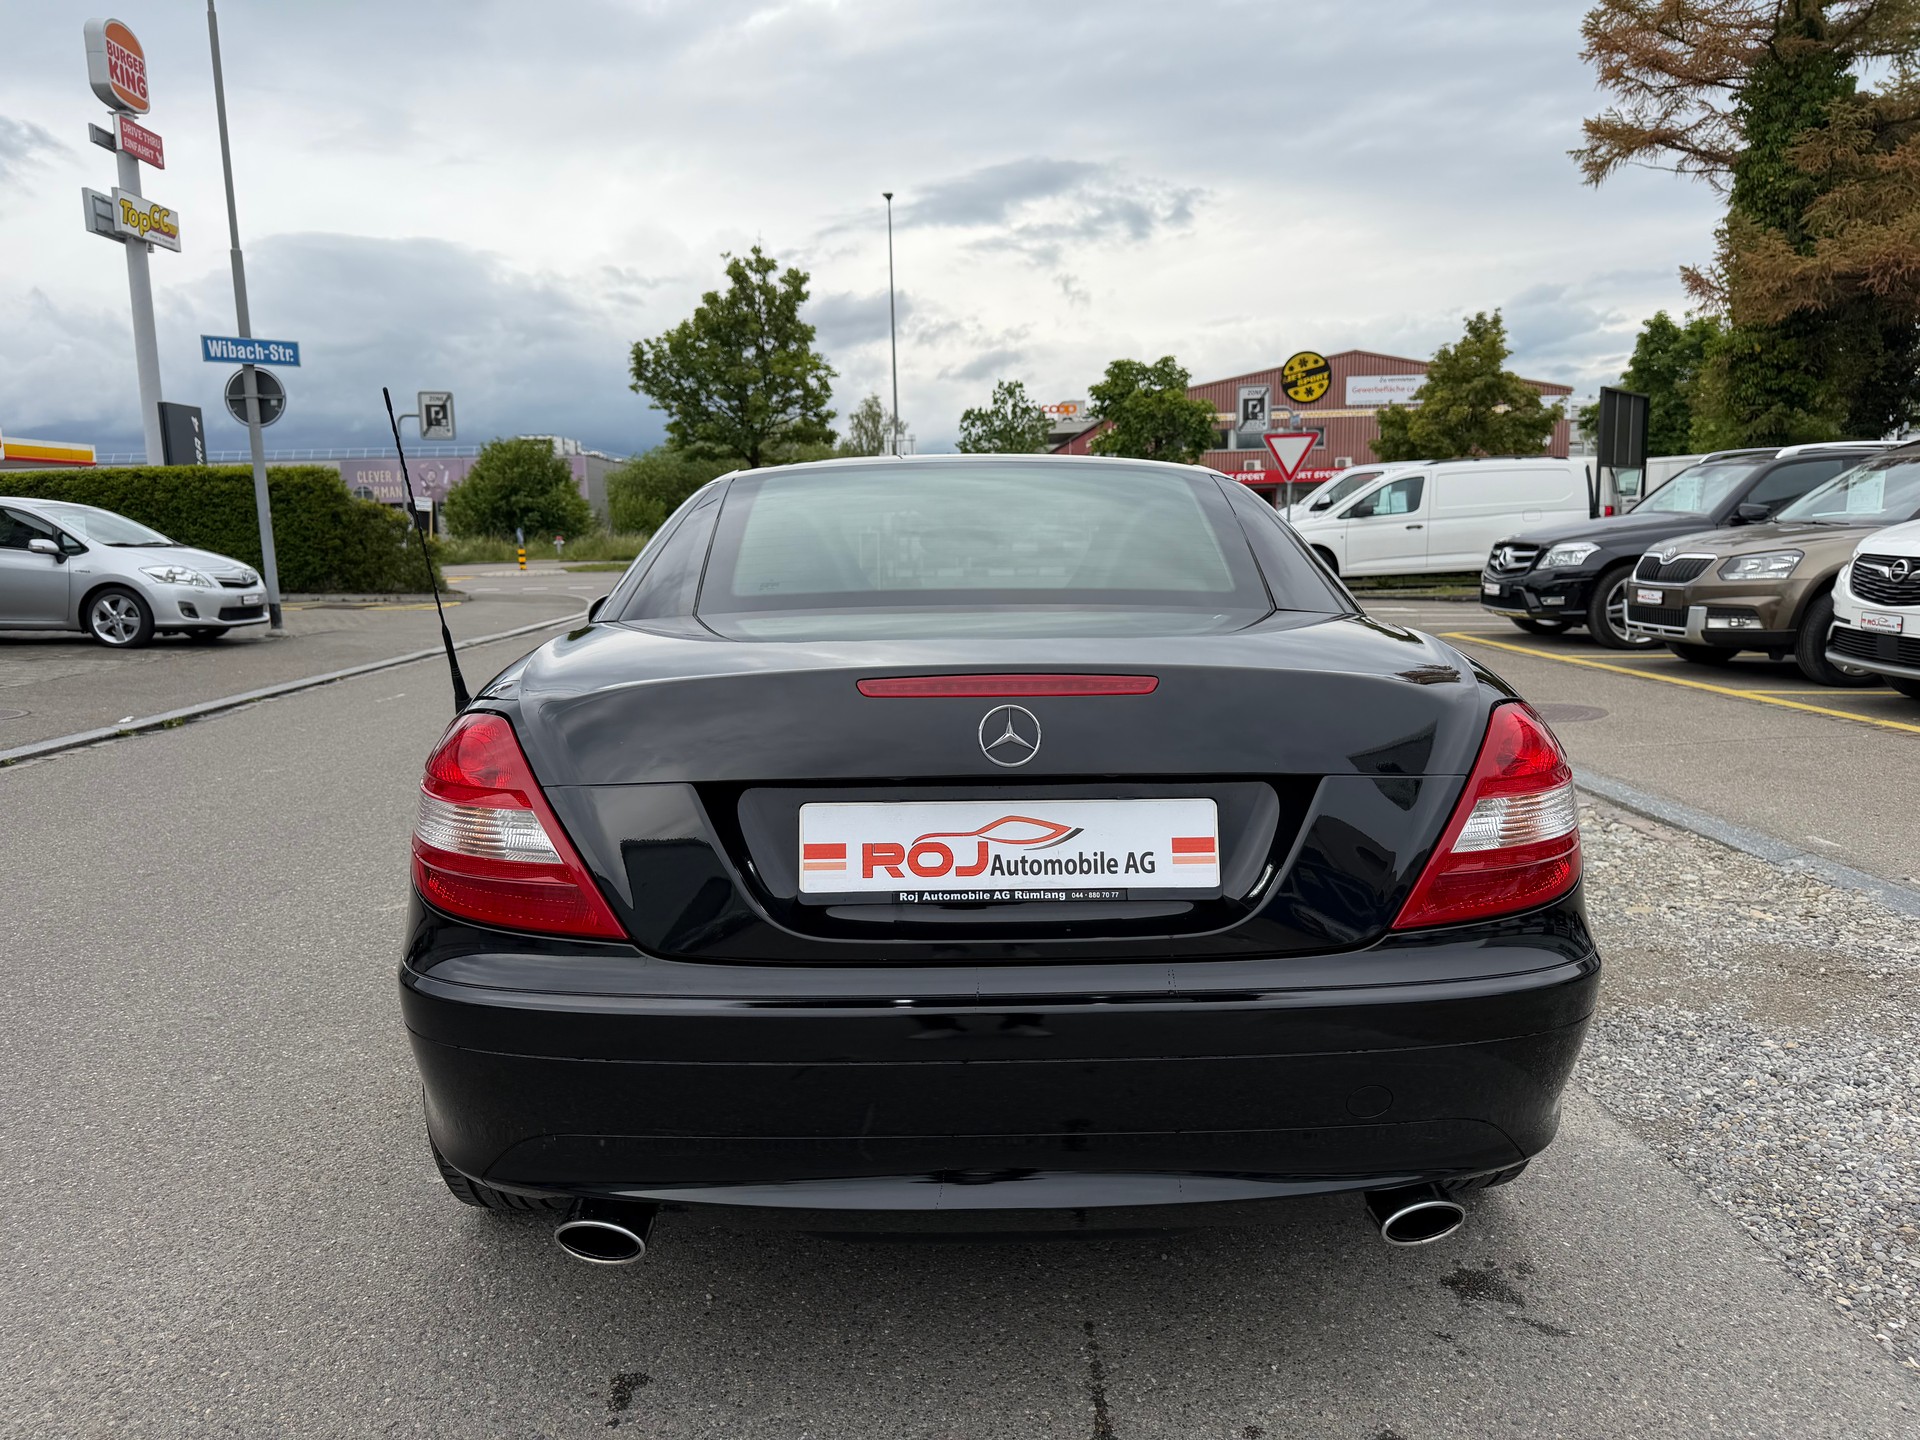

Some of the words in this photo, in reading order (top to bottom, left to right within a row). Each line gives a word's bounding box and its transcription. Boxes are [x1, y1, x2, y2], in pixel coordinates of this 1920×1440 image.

[106, 39, 145, 77] BURGER
[108, 57, 147, 99] KING
[122, 121, 143, 140] DRIVE
[143, 132, 161, 149] THRU
[124, 136, 154, 159] EINFAHRT
[119, 198, 170, 237] TopCC
[207, 340, 294, 362] Wibach-Str.
[1297, 371, 1330, 387] SPORT
[1041, 404, 1077, 416] coop
[357, 470, 392, 483] CLEVER
[1236, 472, 1266, 481] SPORT
[1296, 471, 1313, 480] JET
[862, 841, 989, 879] ROJ
[990, 852, 1118, 876] Automobile
[1125, 851, 1156, 874] AG
[900, 892, 919, 902] Roj
[922, 891, 990, 901] Automobile
[993, 891, 1011, 899] AG
[1014, 890, 1066, 900] Rümlang
